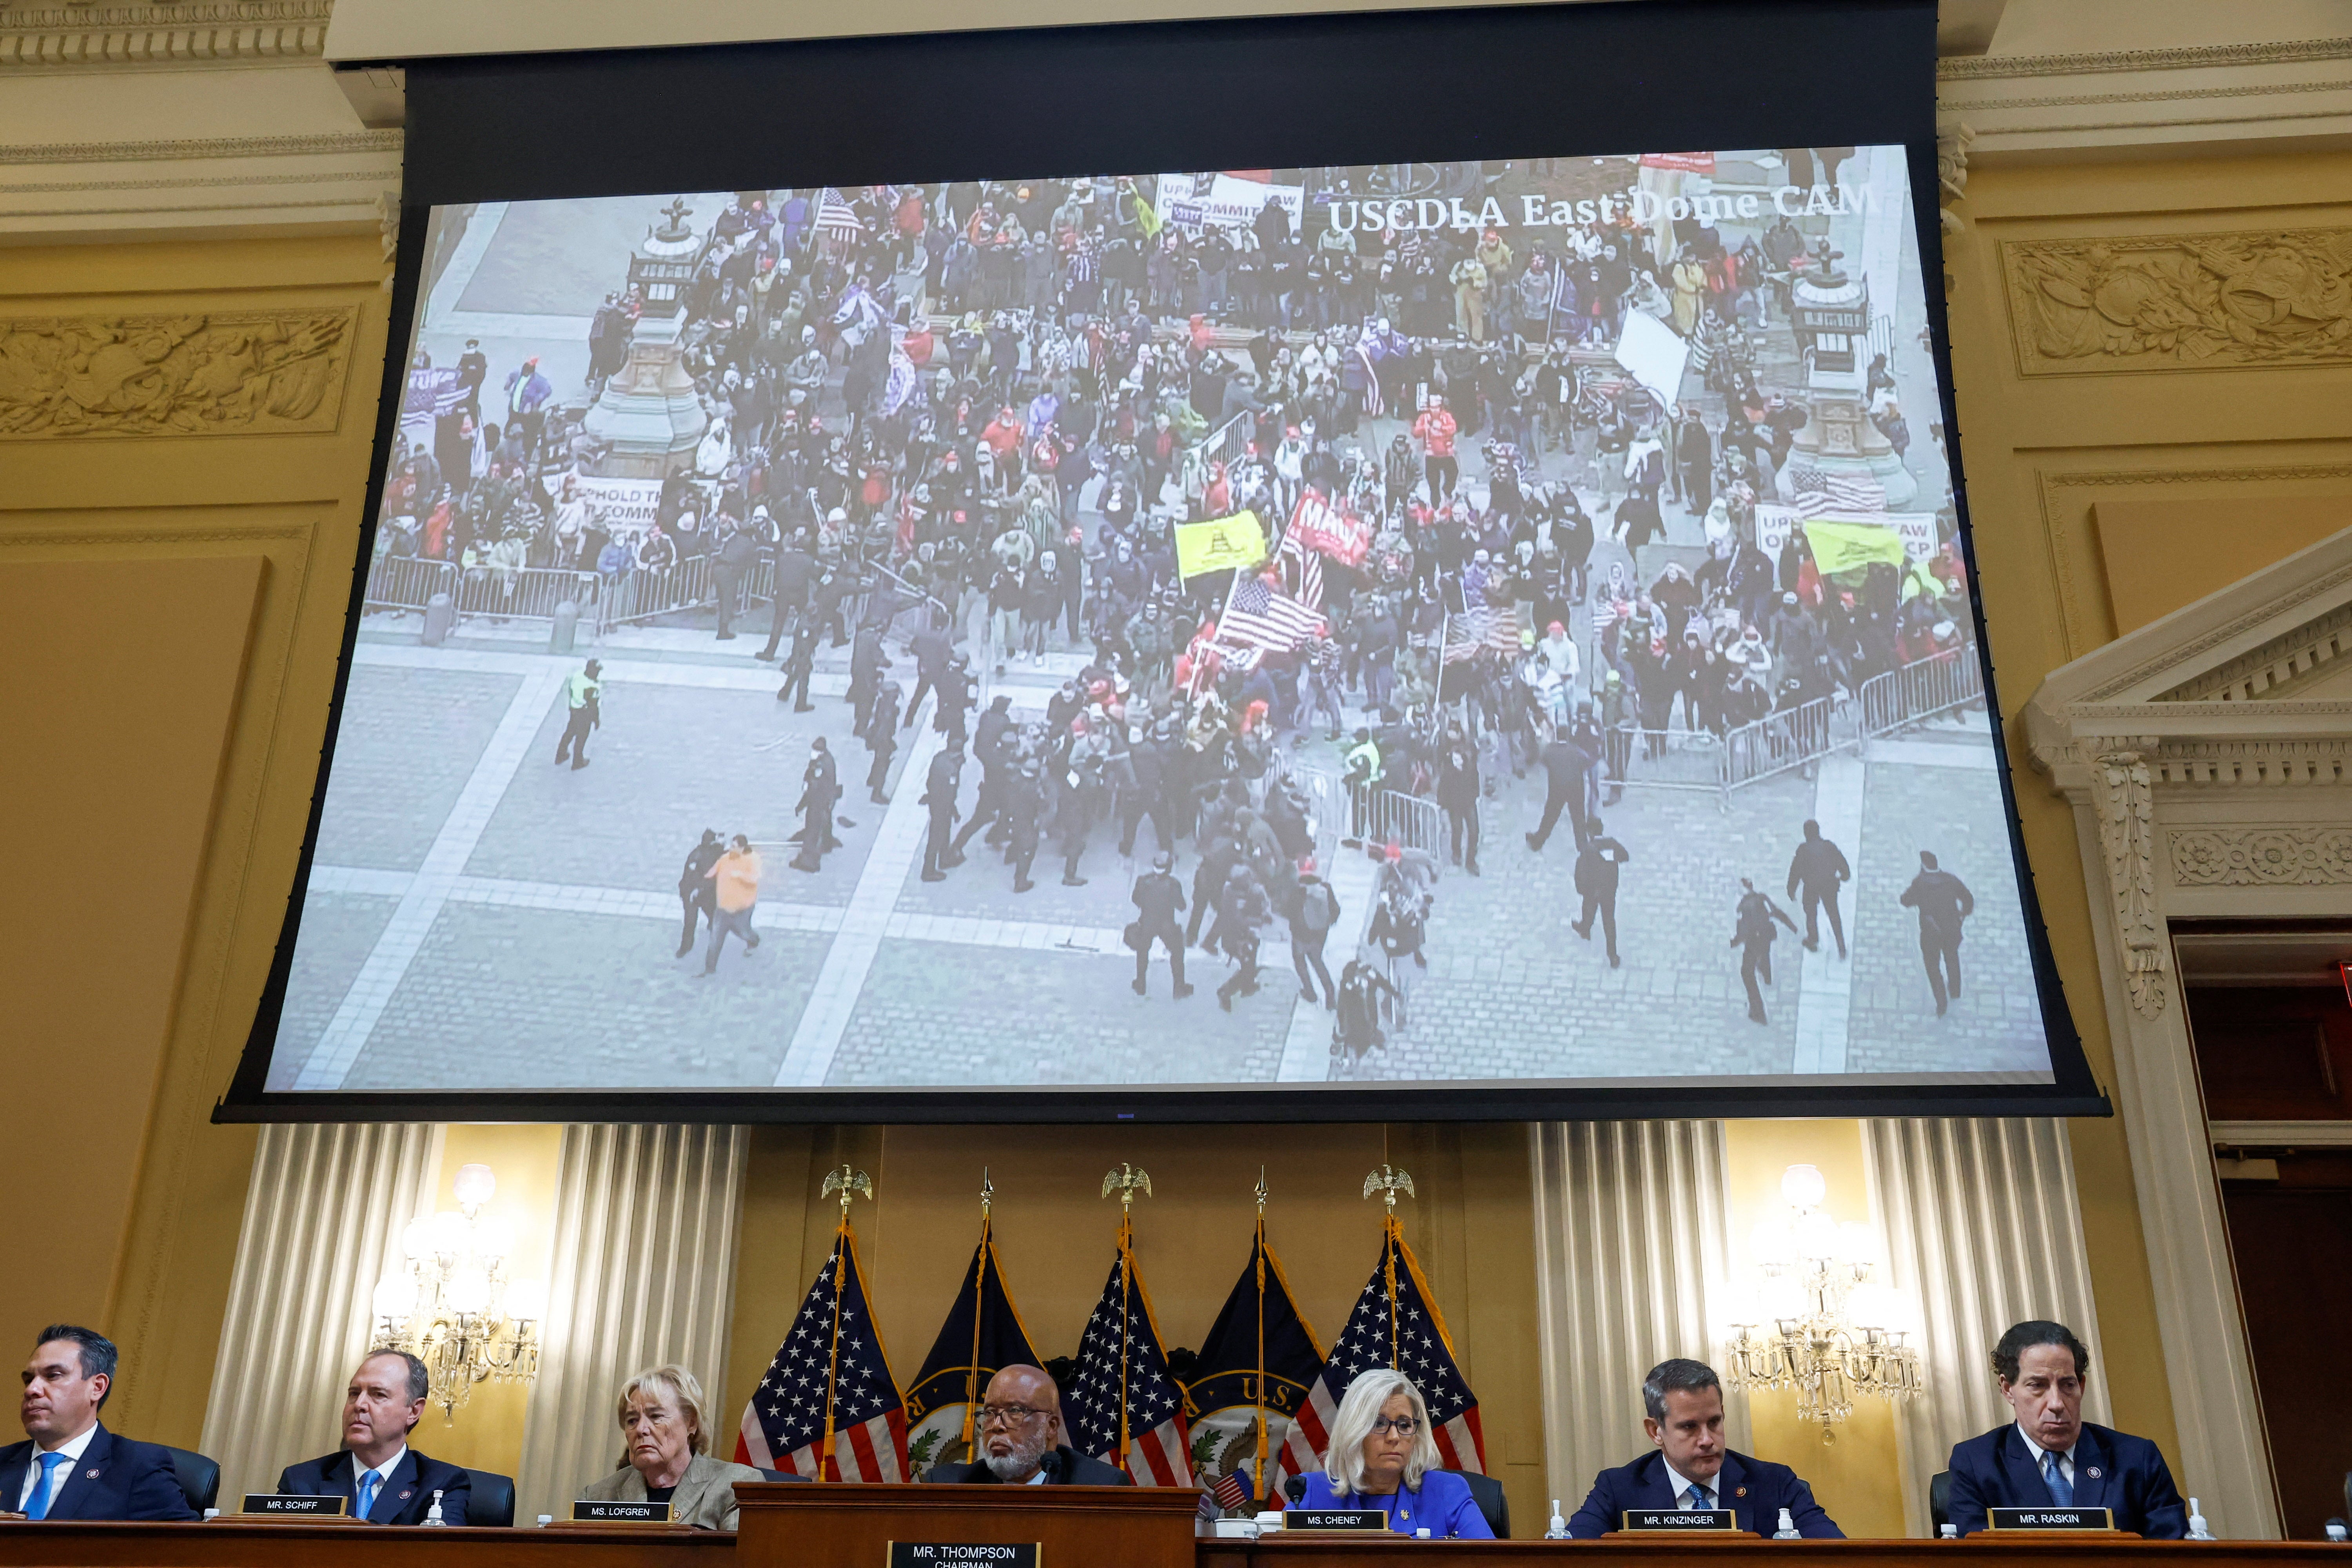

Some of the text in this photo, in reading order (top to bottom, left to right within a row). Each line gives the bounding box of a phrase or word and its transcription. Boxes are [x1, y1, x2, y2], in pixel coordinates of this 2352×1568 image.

[1521, 194, 1617, 226] East
[1628, 186, 1759, 221] Dome
[1771, 182, 1881, 217] CAM
[285, 1501, 318, 1509] SCHIFF
[1664, 1515, 1714, 1524] KINZINGER
[2020, 1514, 2079, 1524] MR. RASKIN
[913, 1546, 1015, 1559] MR. THOMPSON
